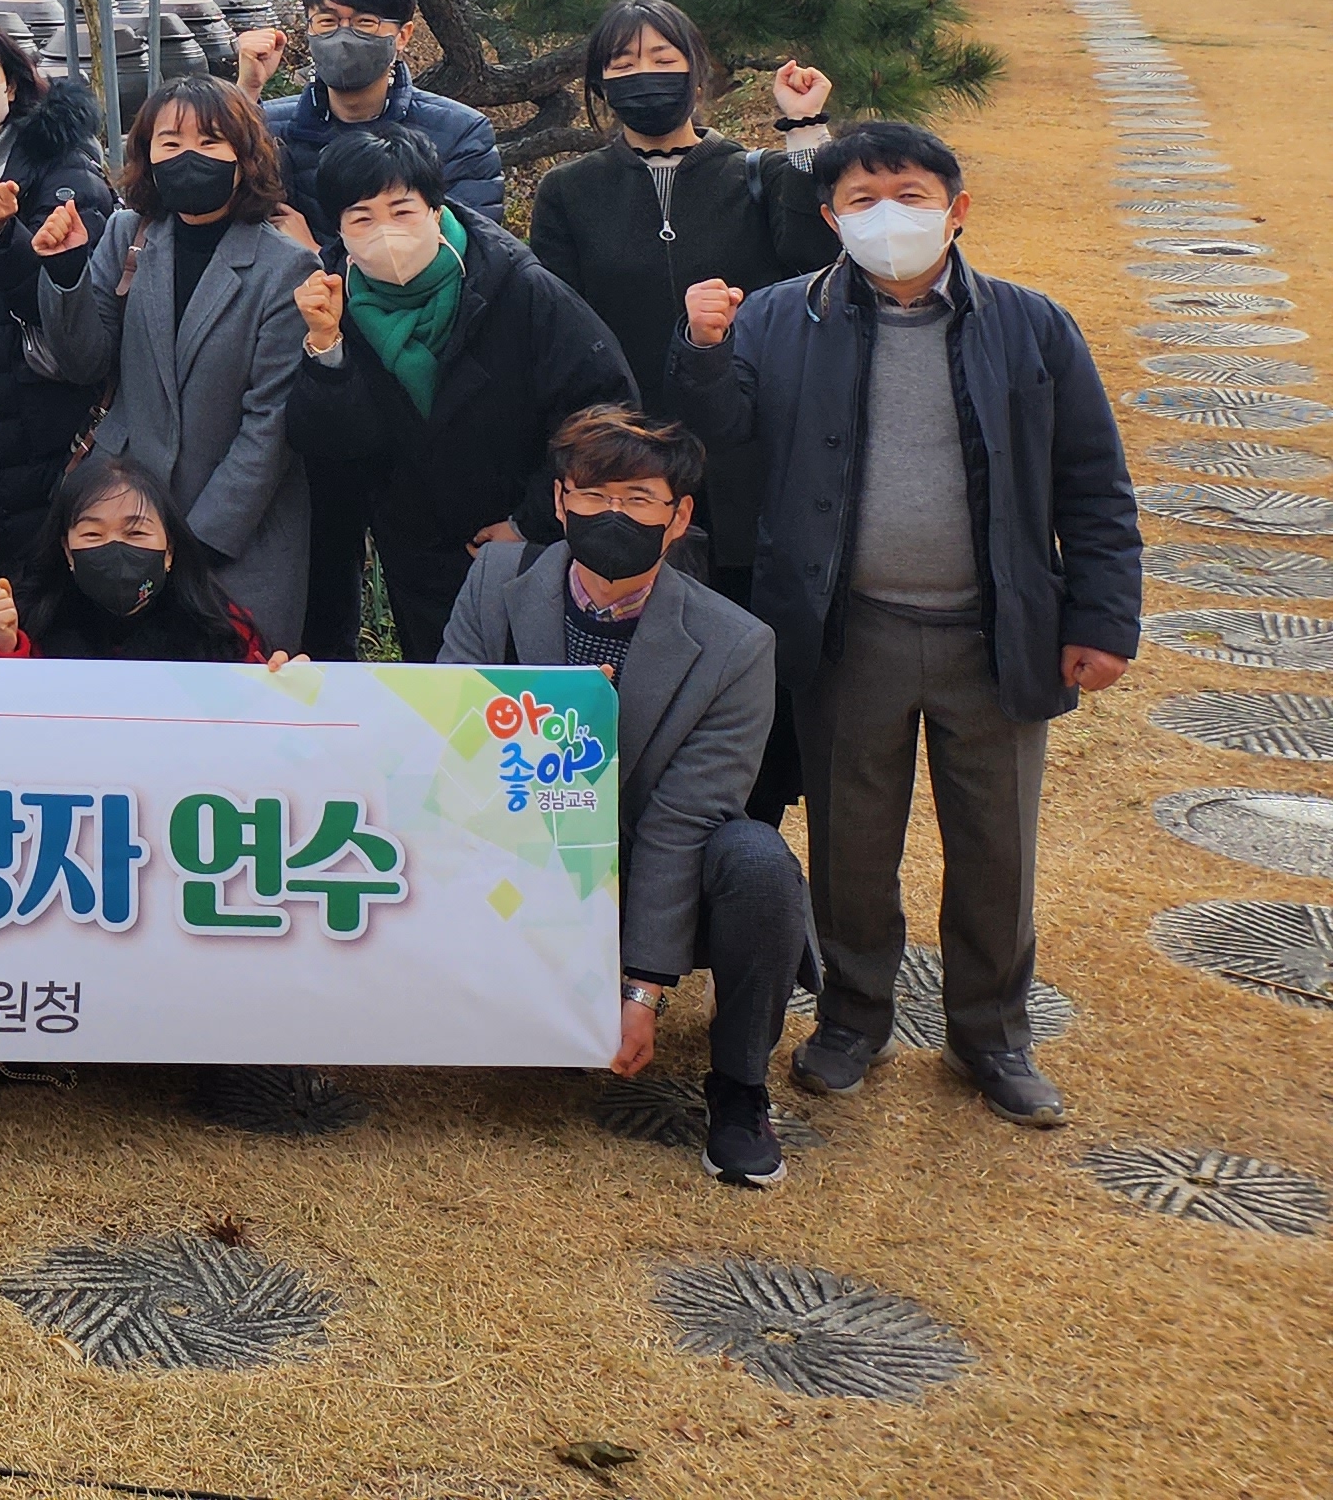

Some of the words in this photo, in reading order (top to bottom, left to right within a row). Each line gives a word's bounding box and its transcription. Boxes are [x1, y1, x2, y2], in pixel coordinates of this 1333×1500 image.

[486, 691, 579, 744] 아이
[499, 736, 605, 813] 좋아
[537, 791, 597, 811] 경남교육
[169, 794, 402, 932] 연수
